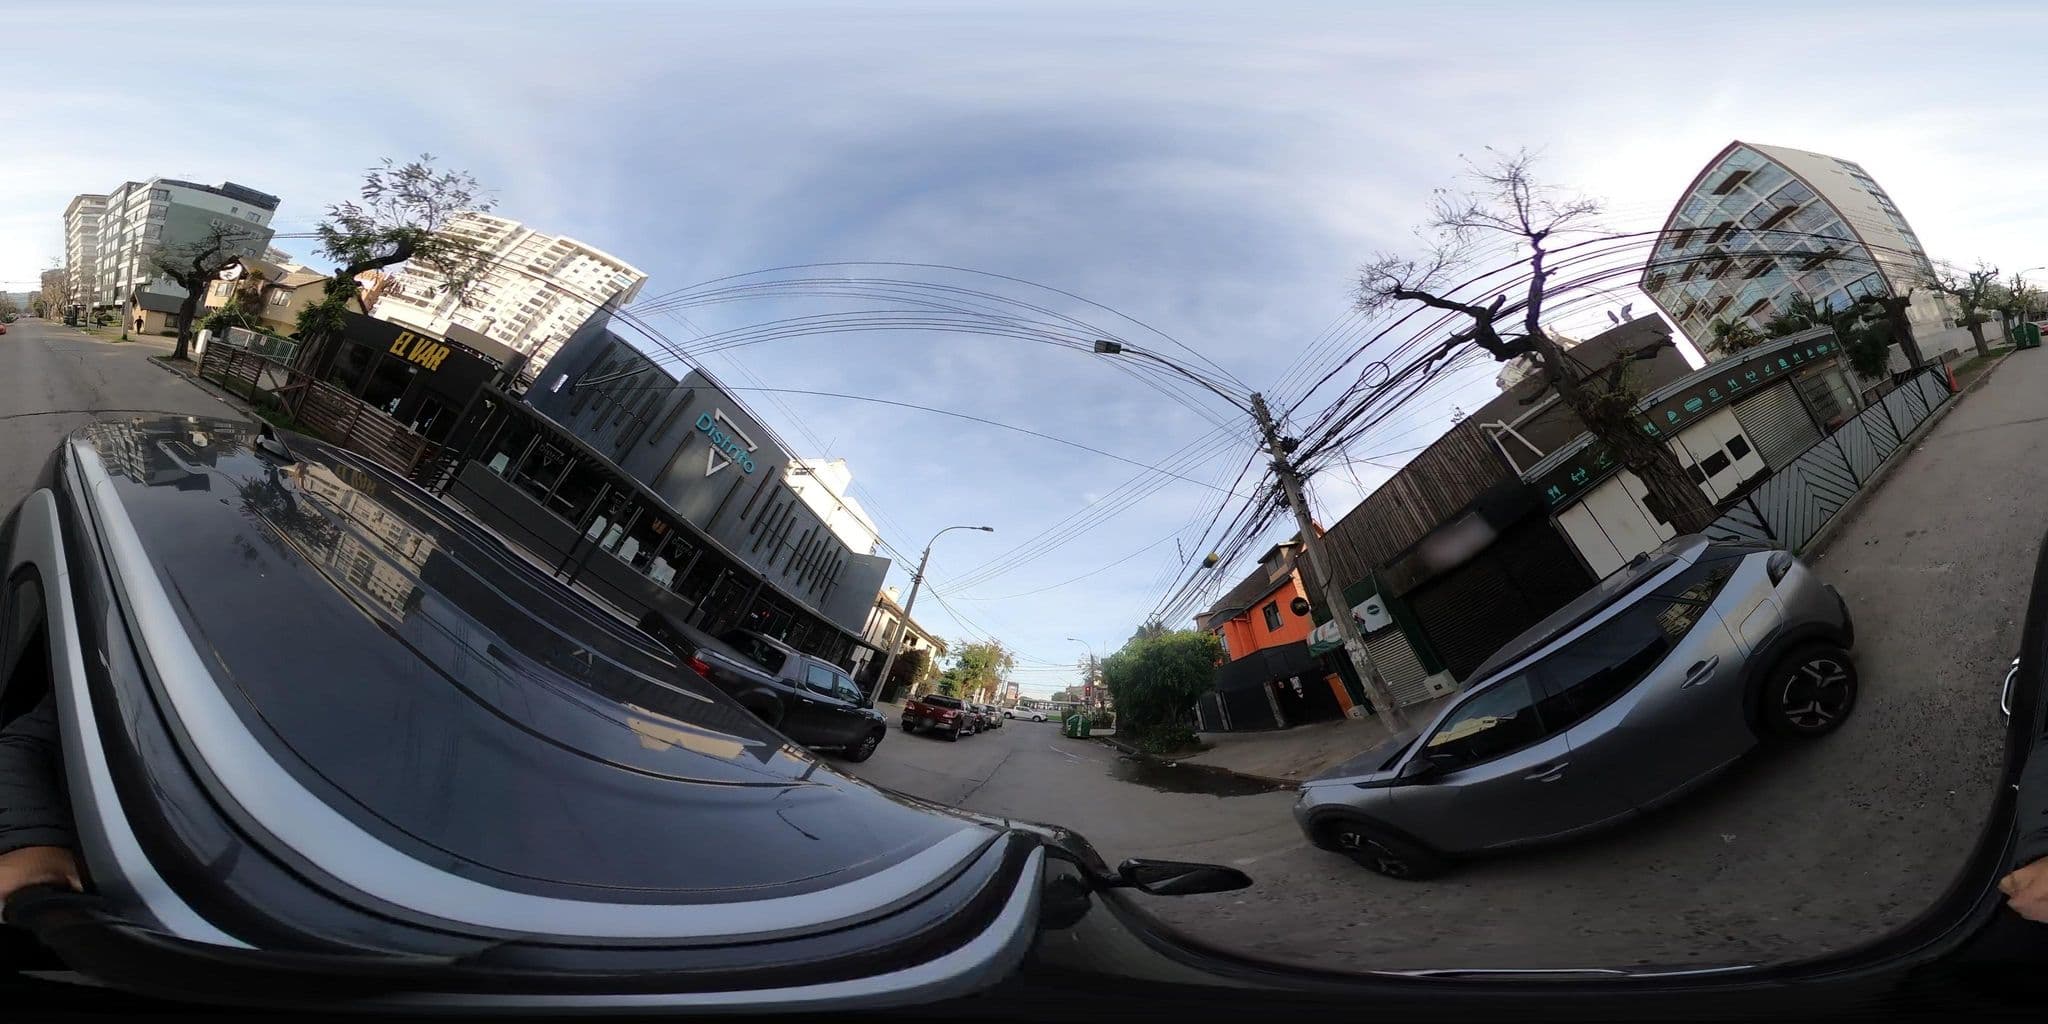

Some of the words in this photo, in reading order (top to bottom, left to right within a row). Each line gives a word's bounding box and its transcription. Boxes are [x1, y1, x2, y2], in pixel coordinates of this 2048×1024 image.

[390, 331, 414, 356] EL
[407, 338, 449, 371] VAR
[696, 412, 754, 474] Distrito
